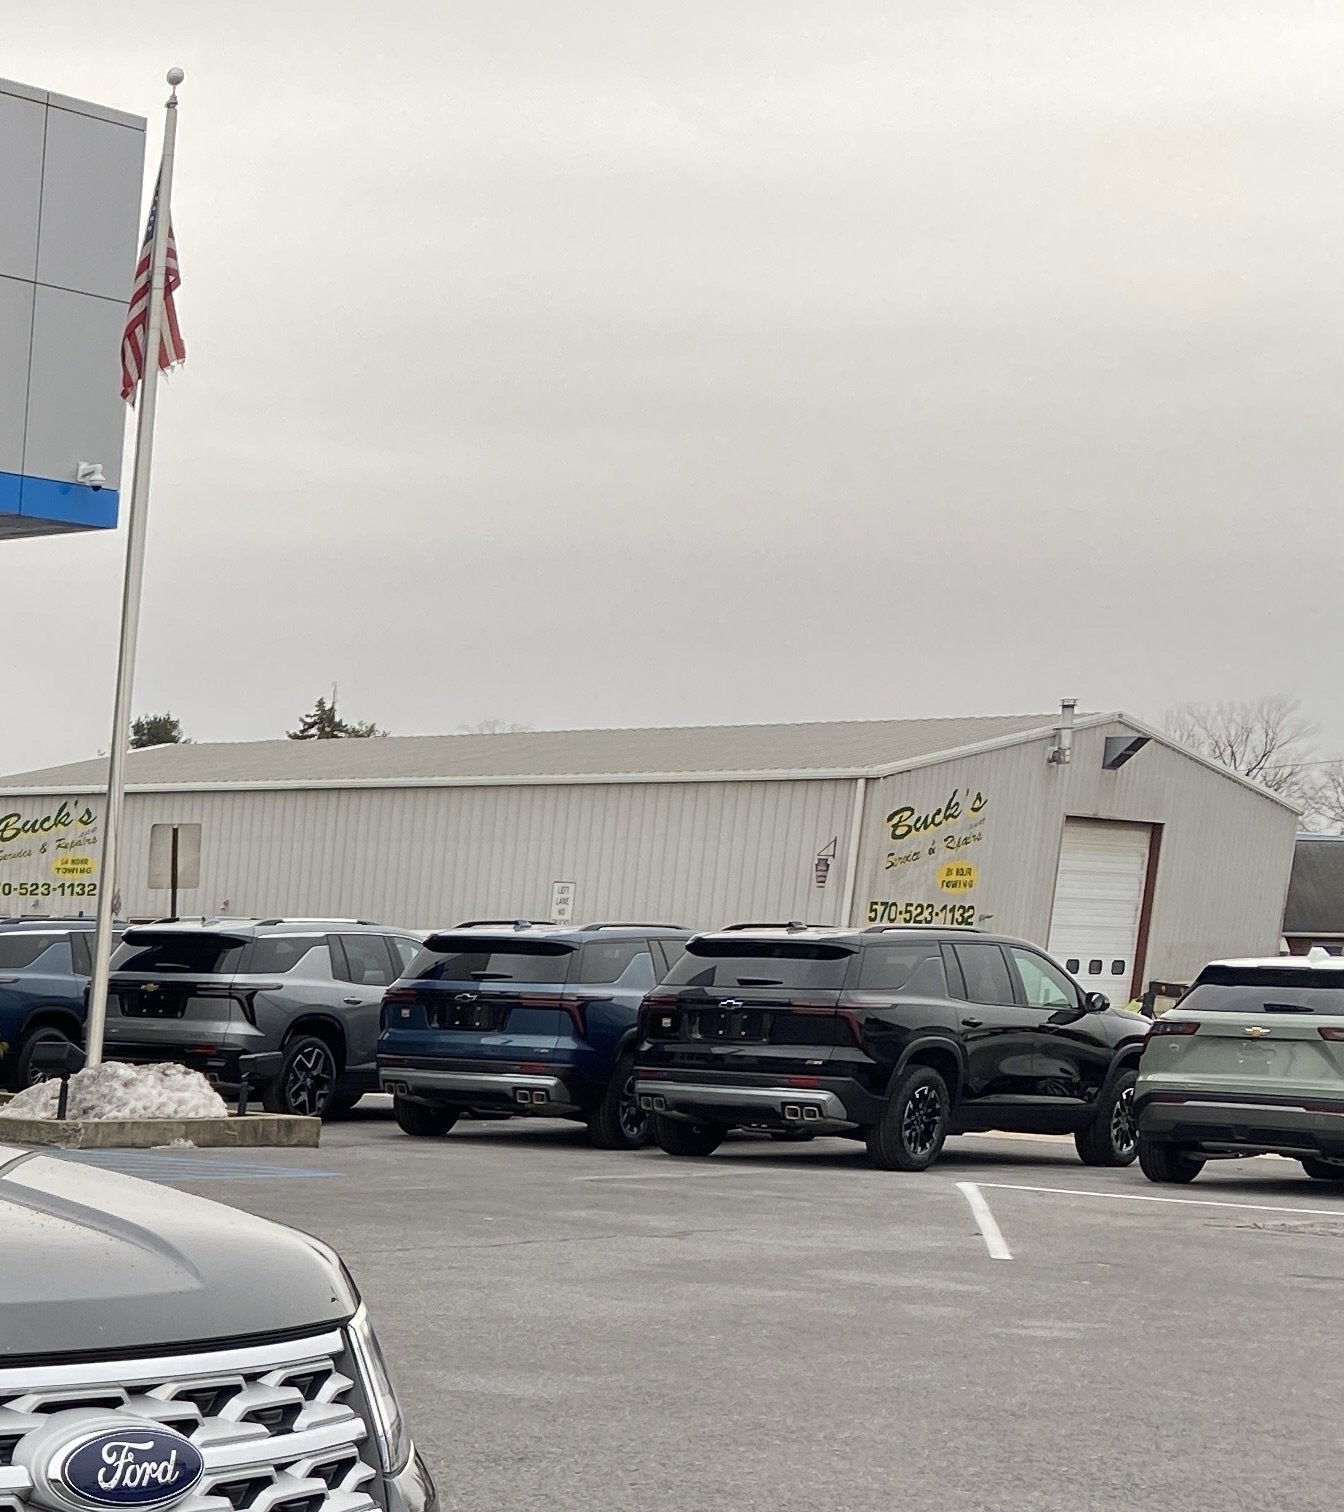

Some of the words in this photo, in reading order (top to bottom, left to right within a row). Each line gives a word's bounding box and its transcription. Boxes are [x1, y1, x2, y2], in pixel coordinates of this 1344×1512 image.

[886, 787, 988, 840] Buck's
[55, 867, 92, 875] TOWING
[97, 1440, 180, 1491] Ford
